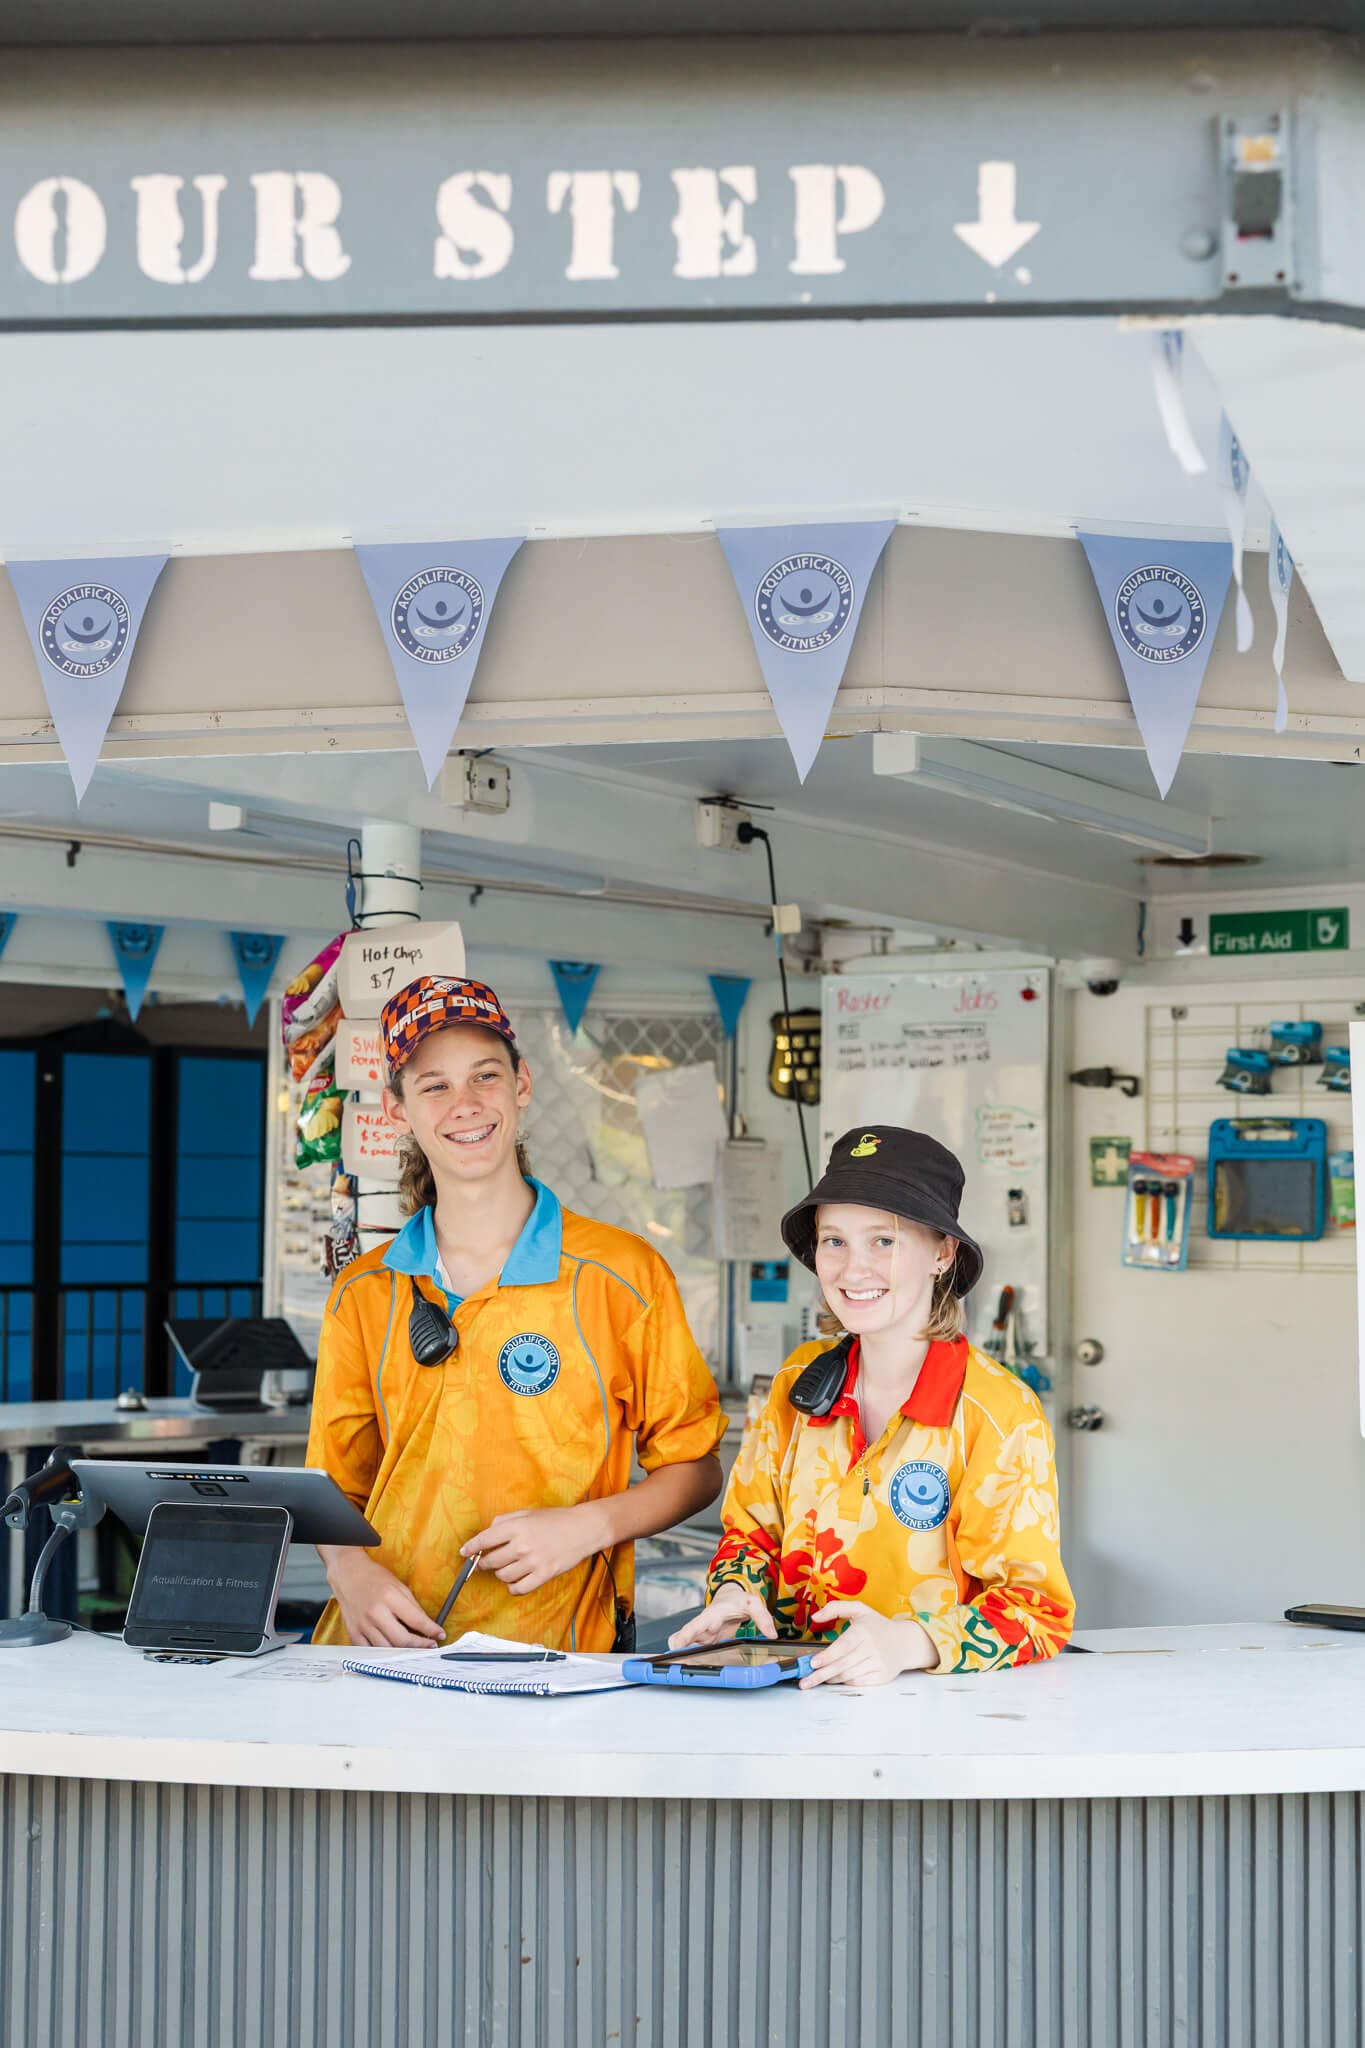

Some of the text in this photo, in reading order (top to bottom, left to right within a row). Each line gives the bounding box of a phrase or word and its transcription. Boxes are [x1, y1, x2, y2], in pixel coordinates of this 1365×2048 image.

[14, 165, 885, 284] OUR STEP
[761, 557, 850, 598] AQUALIFICATION
[398, 570, 481, 610] AQUALIFICATION
[1119, 569, 1201, 610] AQUALIFICATION
[46, 587, 128, 625] AQUALIFICATION
[779, 630, 832, 649] FITNESS
[414, 642, 463, 661] FITNESS
[1136, 643, 1185, 660] FITNESS
[61, 657, 110, 675] FITNESS
[1213, 930, 1292, 951] First Aid
[363, 946, 423, 965] Hot Chips
[370, 967, 395, 990] $7
[389, 996, 499, 1044] RACE ONE
[503, 1336, 558, 1366] AQUALIFICATION
[509, 1380, 541, 1393] FITNESS
[895, 1463, 949, 1497] AQUALIFICATION
[897, 1511, 934, 1529] FITNESS
[152, 1576, 259, 1589] Aqualification & Fitness
